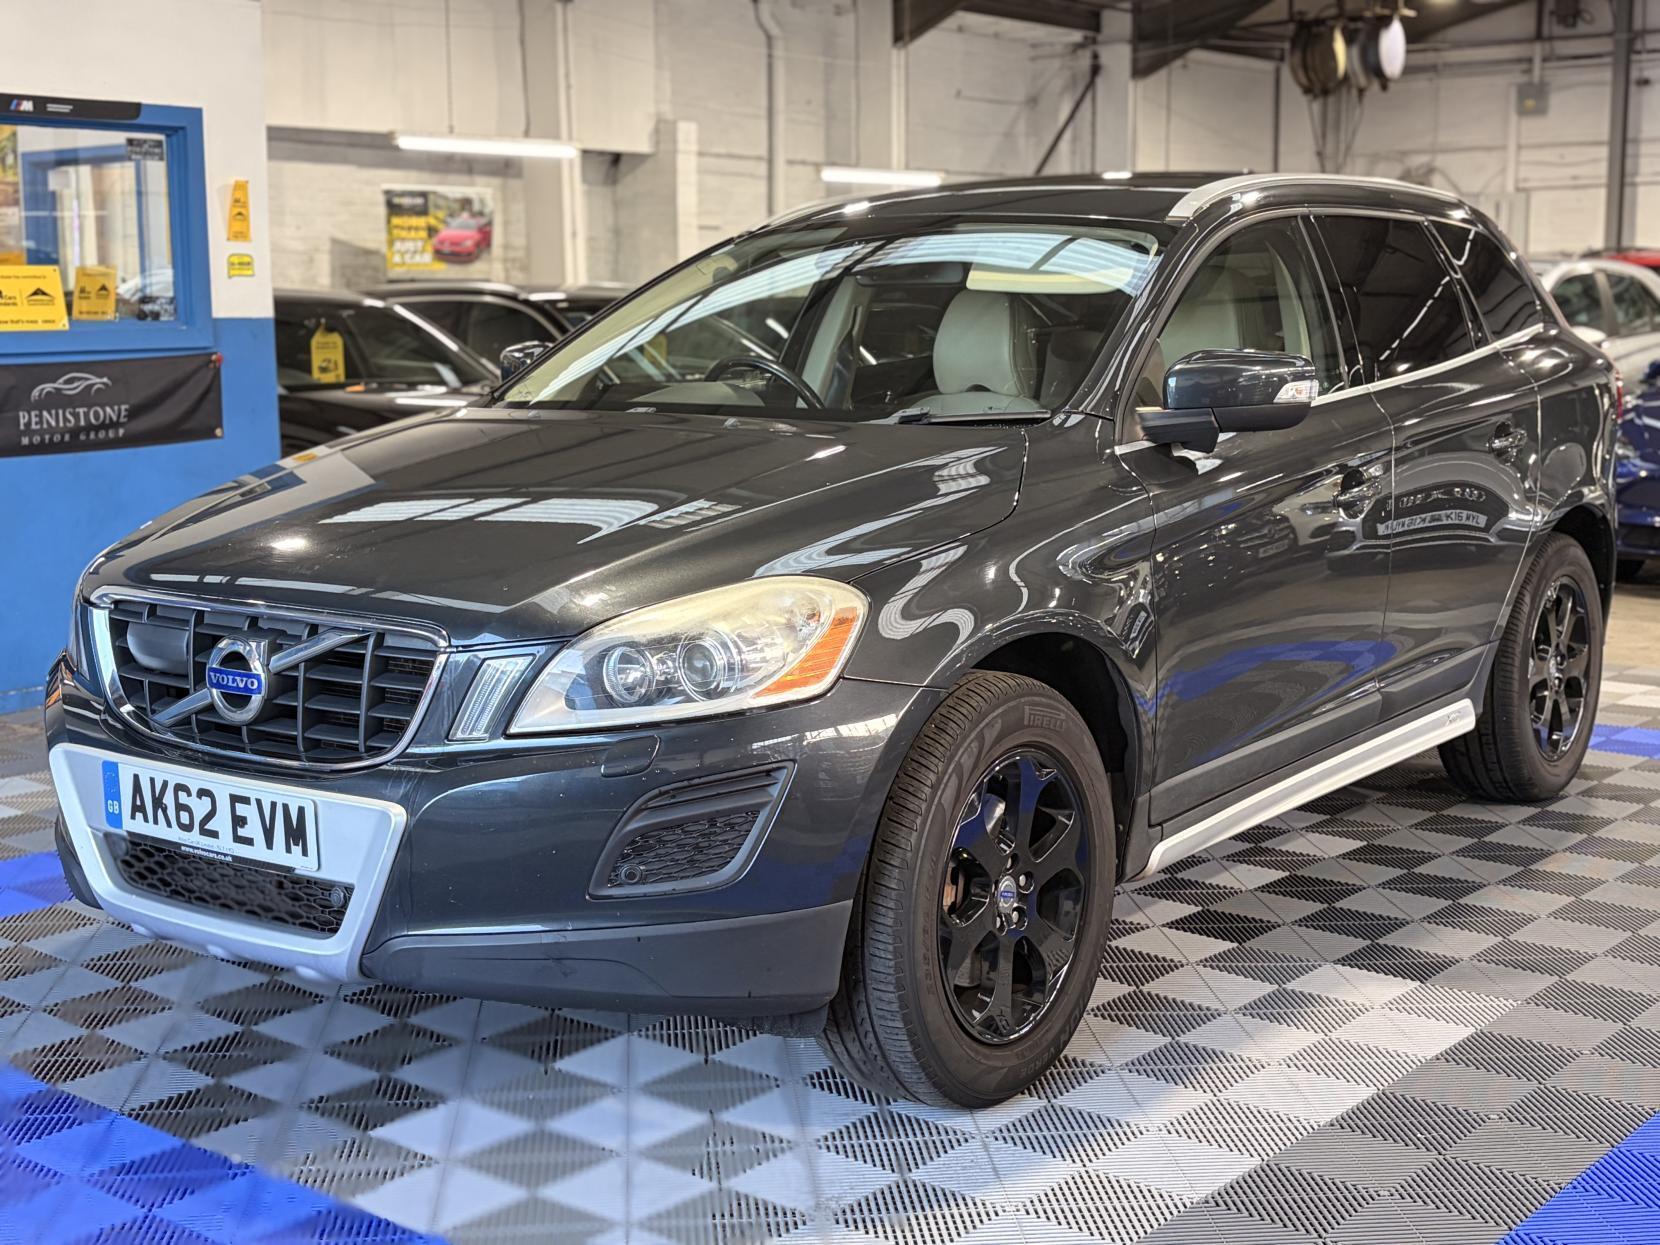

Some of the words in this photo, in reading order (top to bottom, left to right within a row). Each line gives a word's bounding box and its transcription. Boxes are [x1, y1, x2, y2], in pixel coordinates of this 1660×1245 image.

[19, 404, 130, 430] PENISTONE
[21, 433, 71, 446] MOTOR
[79, 428, 126, 440] GROUP
[209, 672, 258, 689] VOLVO
[1024, 705, 1066, 732] PIRELLI
[107, 800, 120, 814] GB
[130, 773, 220, 840] AK62
[228, 793, 309, 857] EVM
